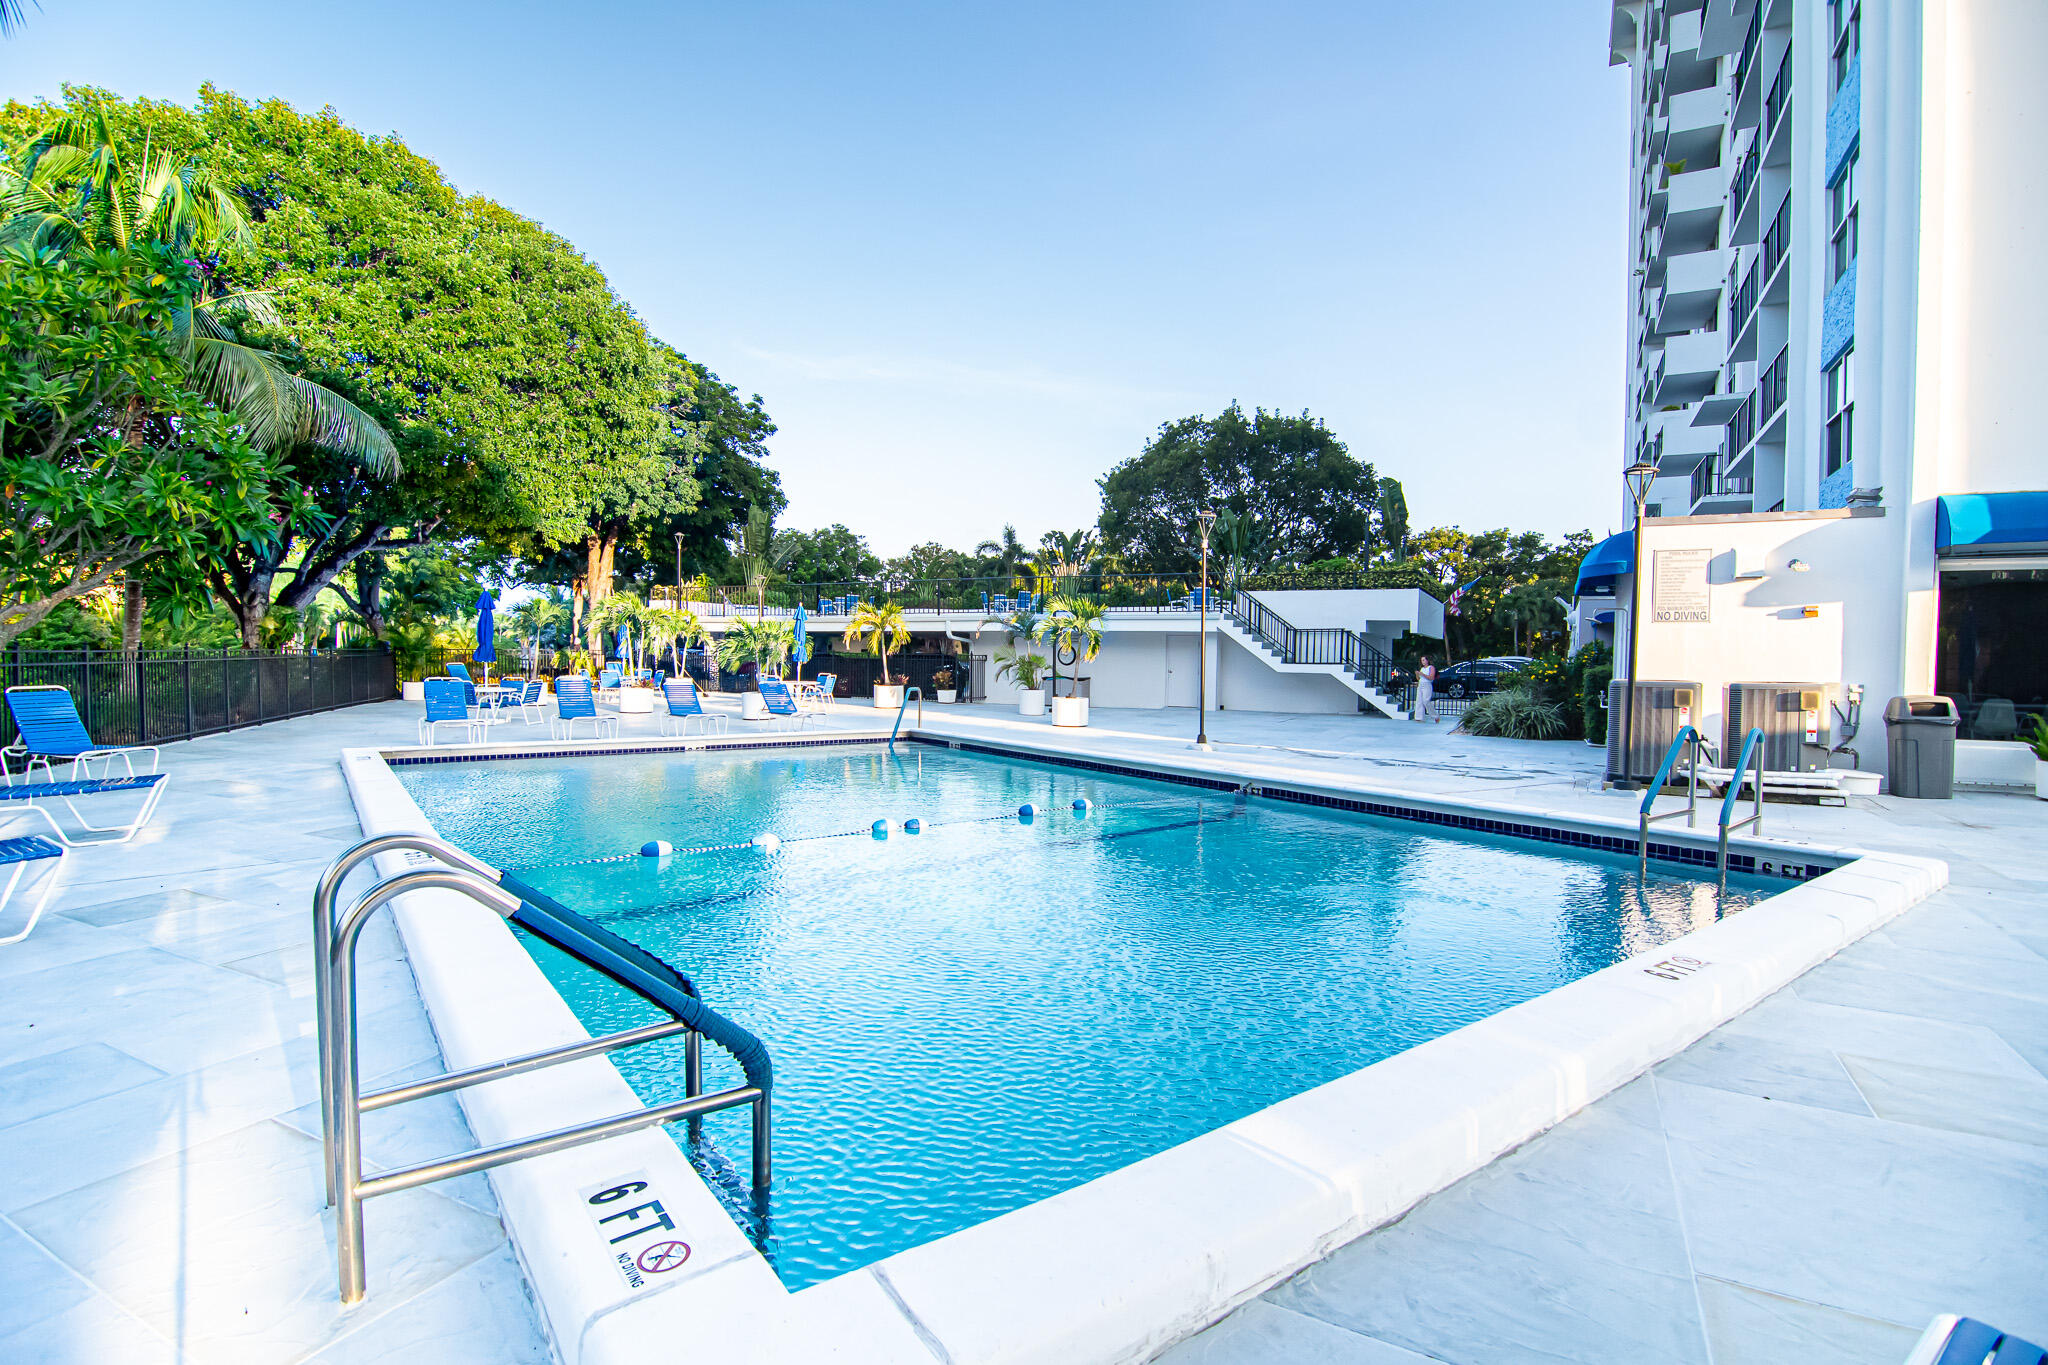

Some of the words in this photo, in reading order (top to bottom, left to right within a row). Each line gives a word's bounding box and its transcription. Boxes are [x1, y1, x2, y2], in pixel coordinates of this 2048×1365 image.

[1656, 611, 1671, 621] NO
[1673, 611, 1707, 621] DIVING
[588, 1181, 648, 1205] 6
[599, 1199, 676, 1245] FT
[616, 1252, 631, 1264] NO
[622, 1262, 644, 1288] DIVING
